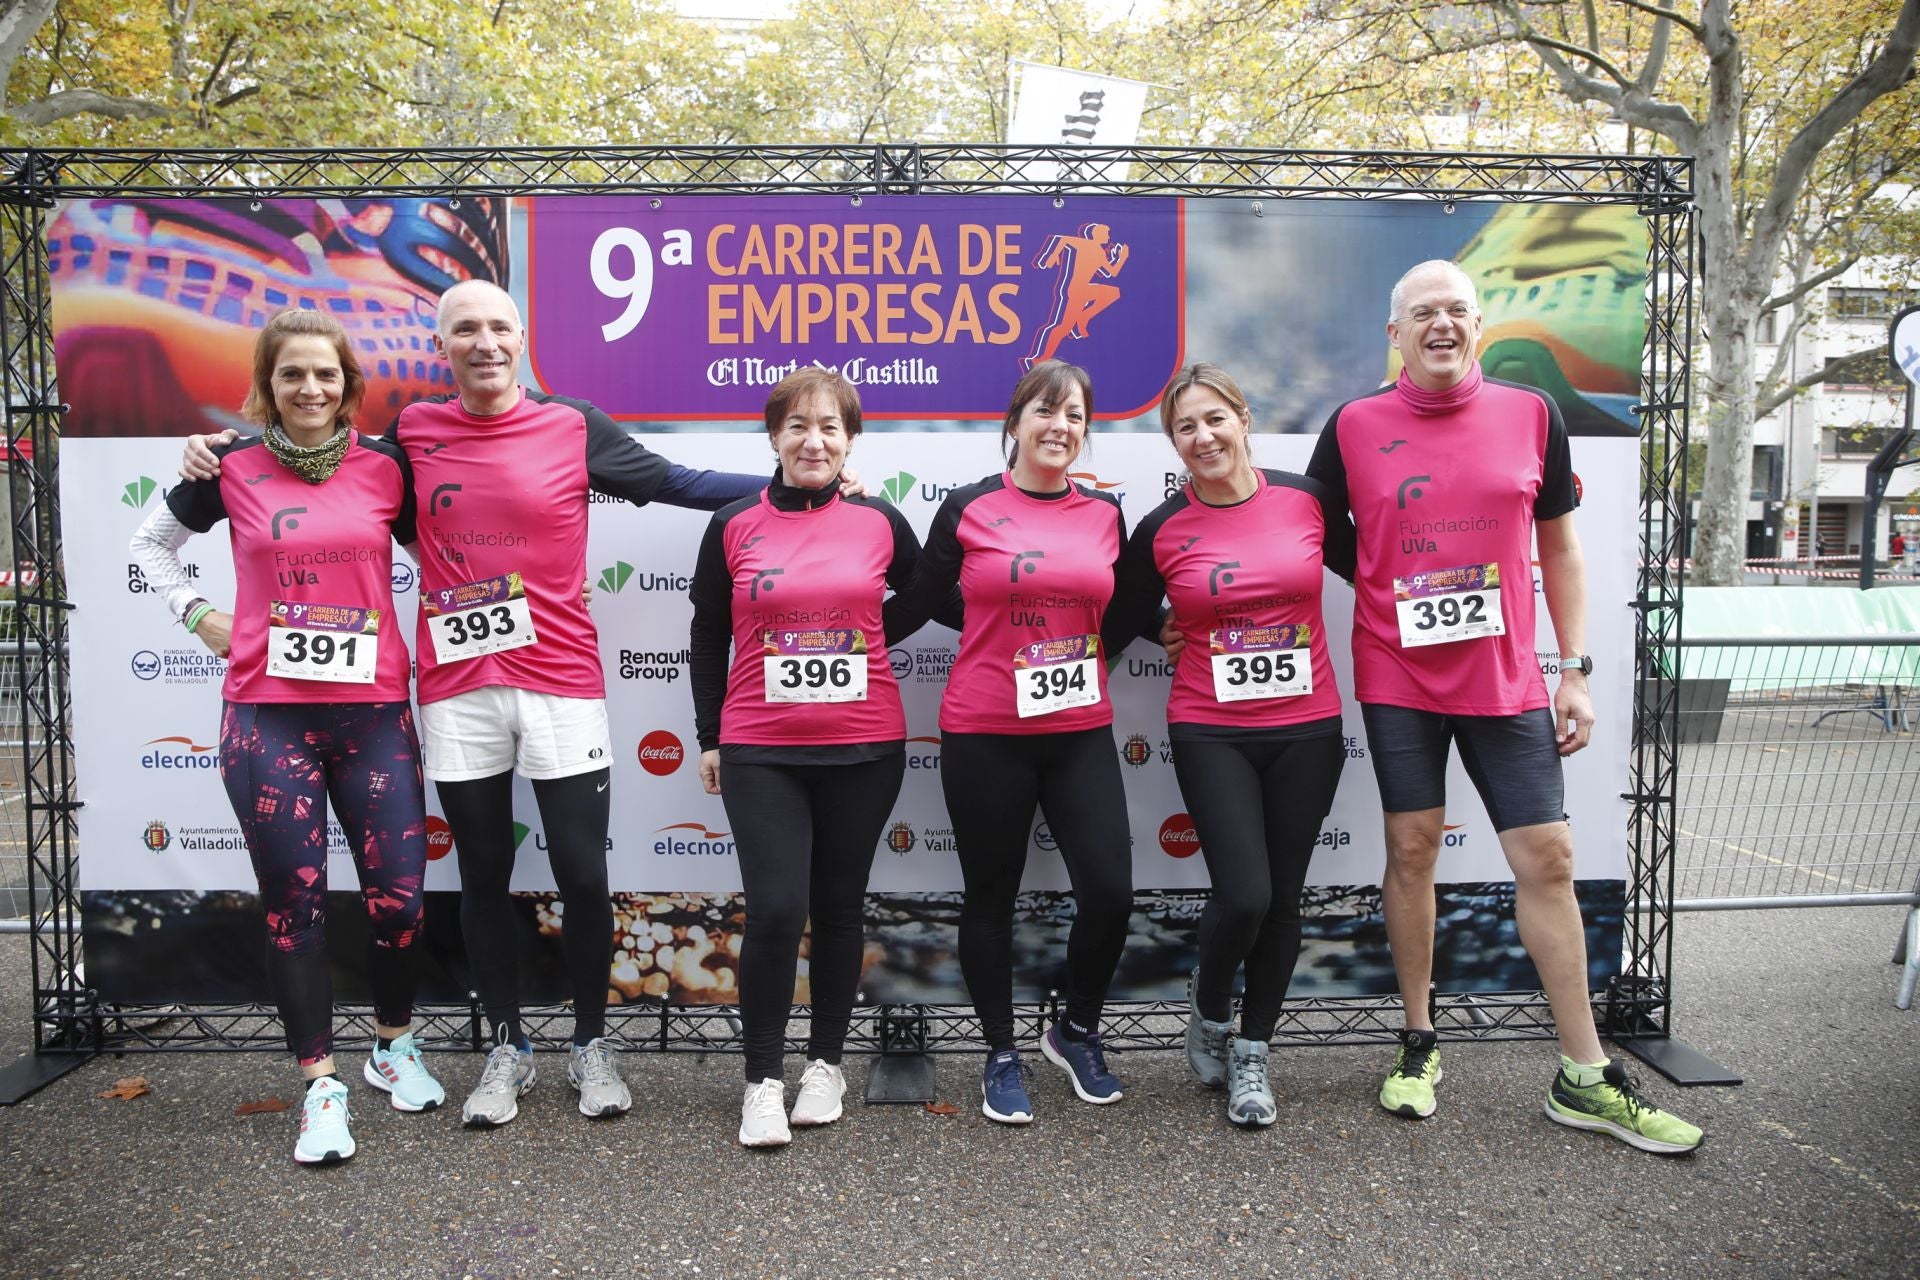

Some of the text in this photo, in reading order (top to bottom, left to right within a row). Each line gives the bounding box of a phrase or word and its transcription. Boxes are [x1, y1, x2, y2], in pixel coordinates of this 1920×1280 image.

[706, 223, 942, 276] CARRERA
[959, 224, 1022, 275] DE
[707, 283, 1022, 344] EMPRESAS
[707, 357, 738, 387] El
[742, 357, 807, 384] Nort
[841, 357, 940, 387] Castilla
[1401, 515, 1498, 535] Fundación
[434, 527, 527, 548] Fundación
[1401, 538, 1438, 555] UVa
[275, 547, 377, 567] Fundación
[279, 569, 319, 588] UVa
[639, 573, 692, 591] Unic
[1427, 576, 1467, 588] EMPRESAS
[308, 605, 340, 616] CARRERA
[1214, 592, 1312, 616] Fundación
[1413, 594, 1487, 631] 392
[307, 612, 349, 624] EMPRESAS
[752, 607, 851, 625] Fundación
[1011, 611, 1047, 627] UVa
[444, 606, 515, 646] 393
[798, 638, 836, 647] EMPRESAS
[1243, 634, 1280, 645] EMPRESAS
[283, 632, 356, 667] 391
[619, 649, 691, 664] Renault
[164, 655, 222, 665] BANCO DE
[916, 654, 957, 664] BANCO
[1129, 658, 1176, 677] Unic
[619, 665, 680, 683] Group
[780, 658, 851, 689] 396
[1226, 653, 1297, 686] 395
[1030, 663, 1086, 700] 394
[141, 750, 220, 769] elecnor
[640, 745, 681, 760] Coca-Cola
[179, 827, 239, 837] Ayuntamiento
[654, 837, 735, 855] elecnor
[924, 838, 958, 852] Valla
